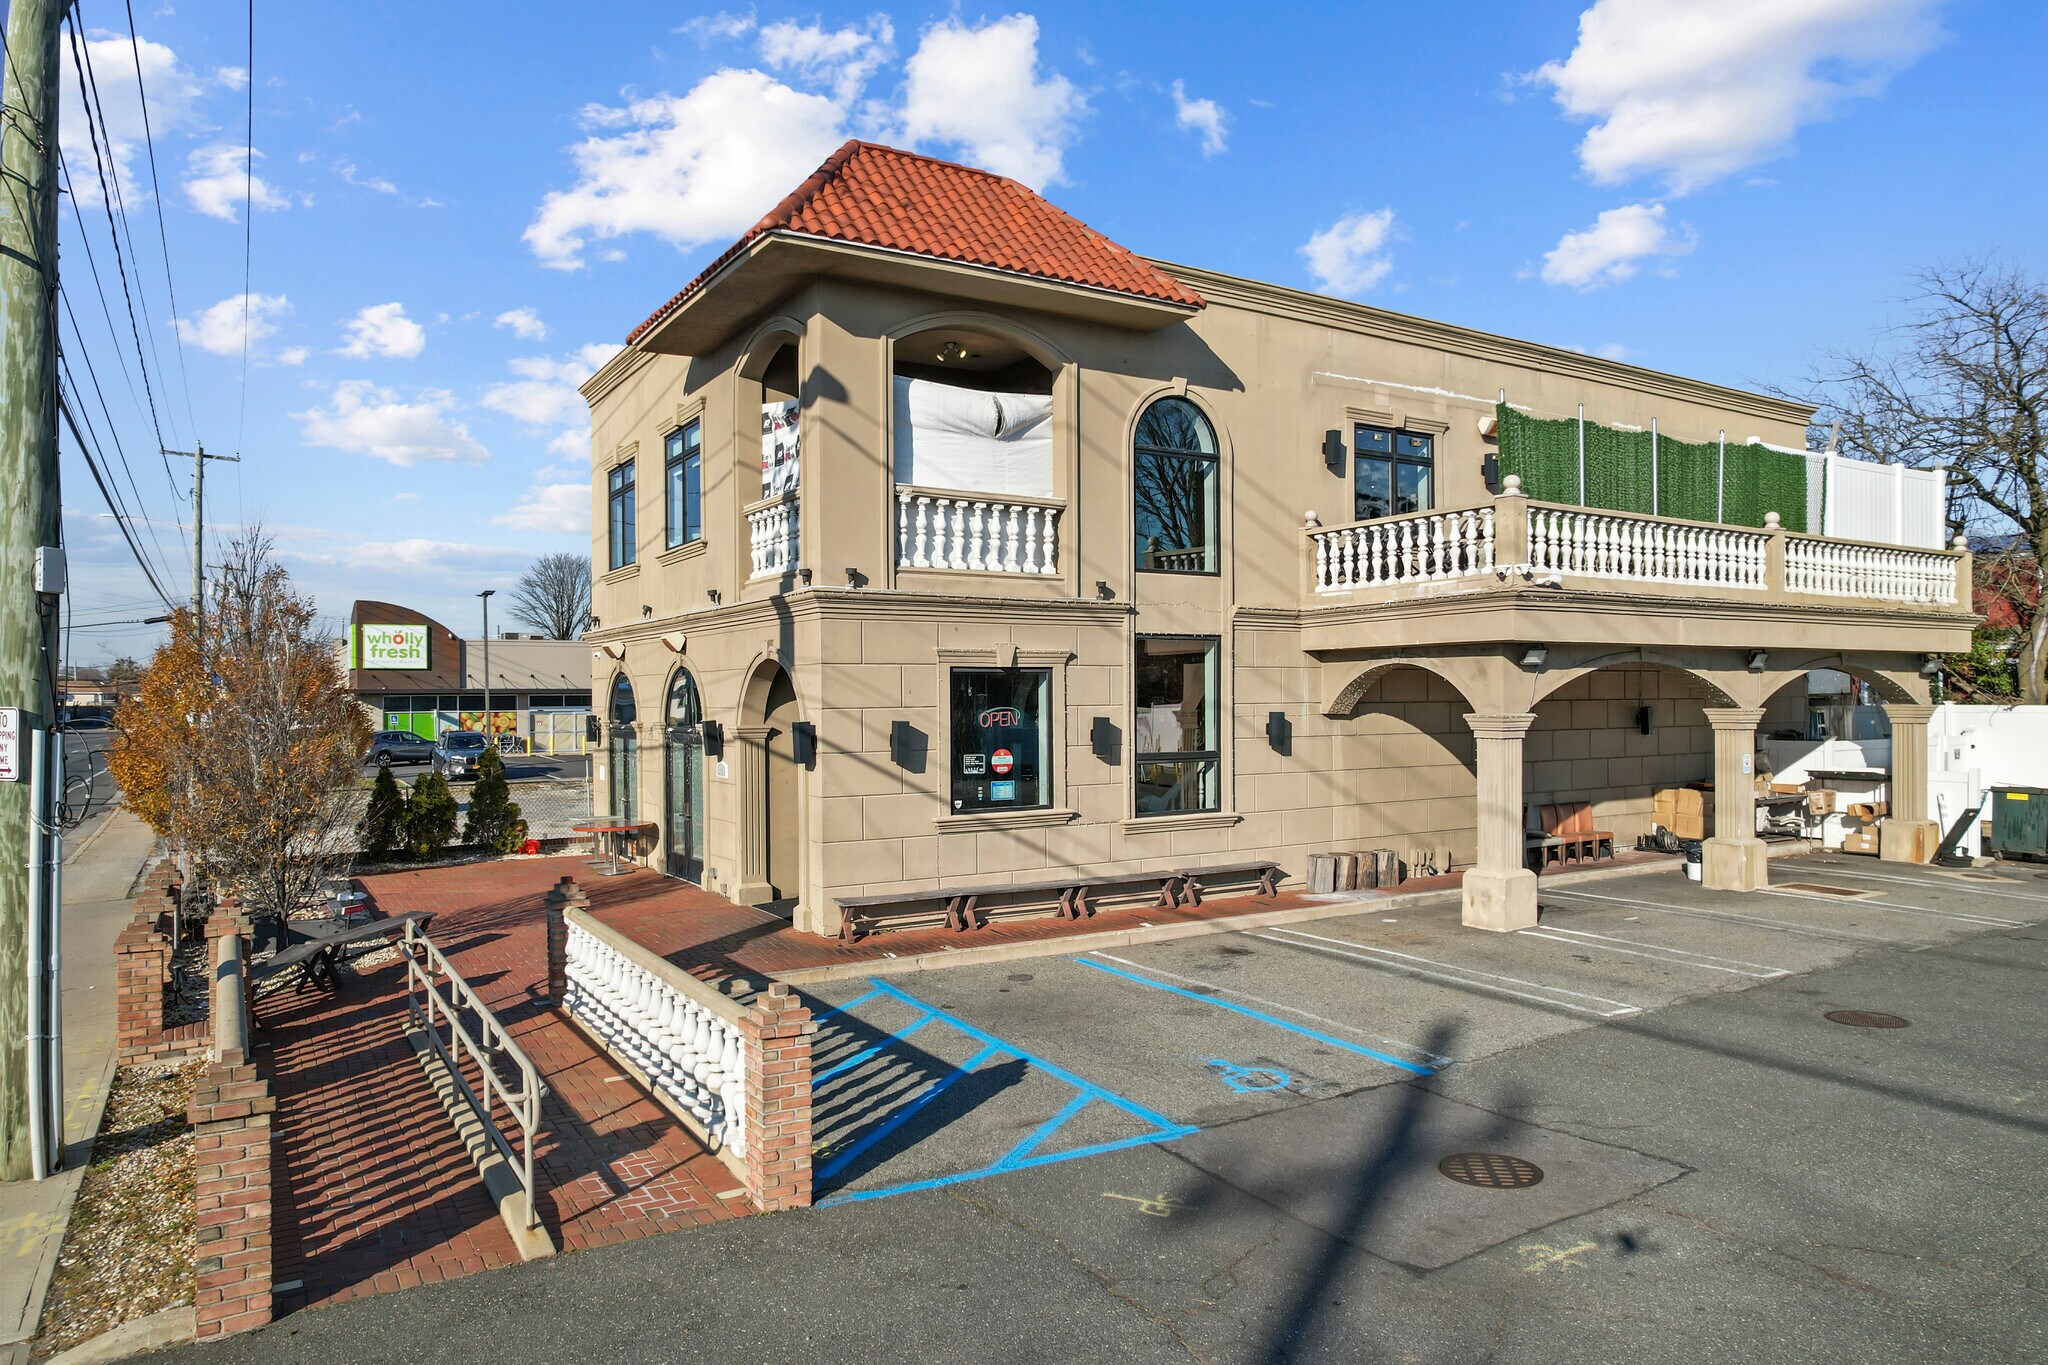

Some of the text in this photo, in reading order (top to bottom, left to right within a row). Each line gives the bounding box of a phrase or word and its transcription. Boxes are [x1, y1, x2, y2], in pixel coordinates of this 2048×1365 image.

[367, 631, 424, 648] wholly
[370, 644, 420, 658] fresh
[980, 711, 1018, 728] OPEN
